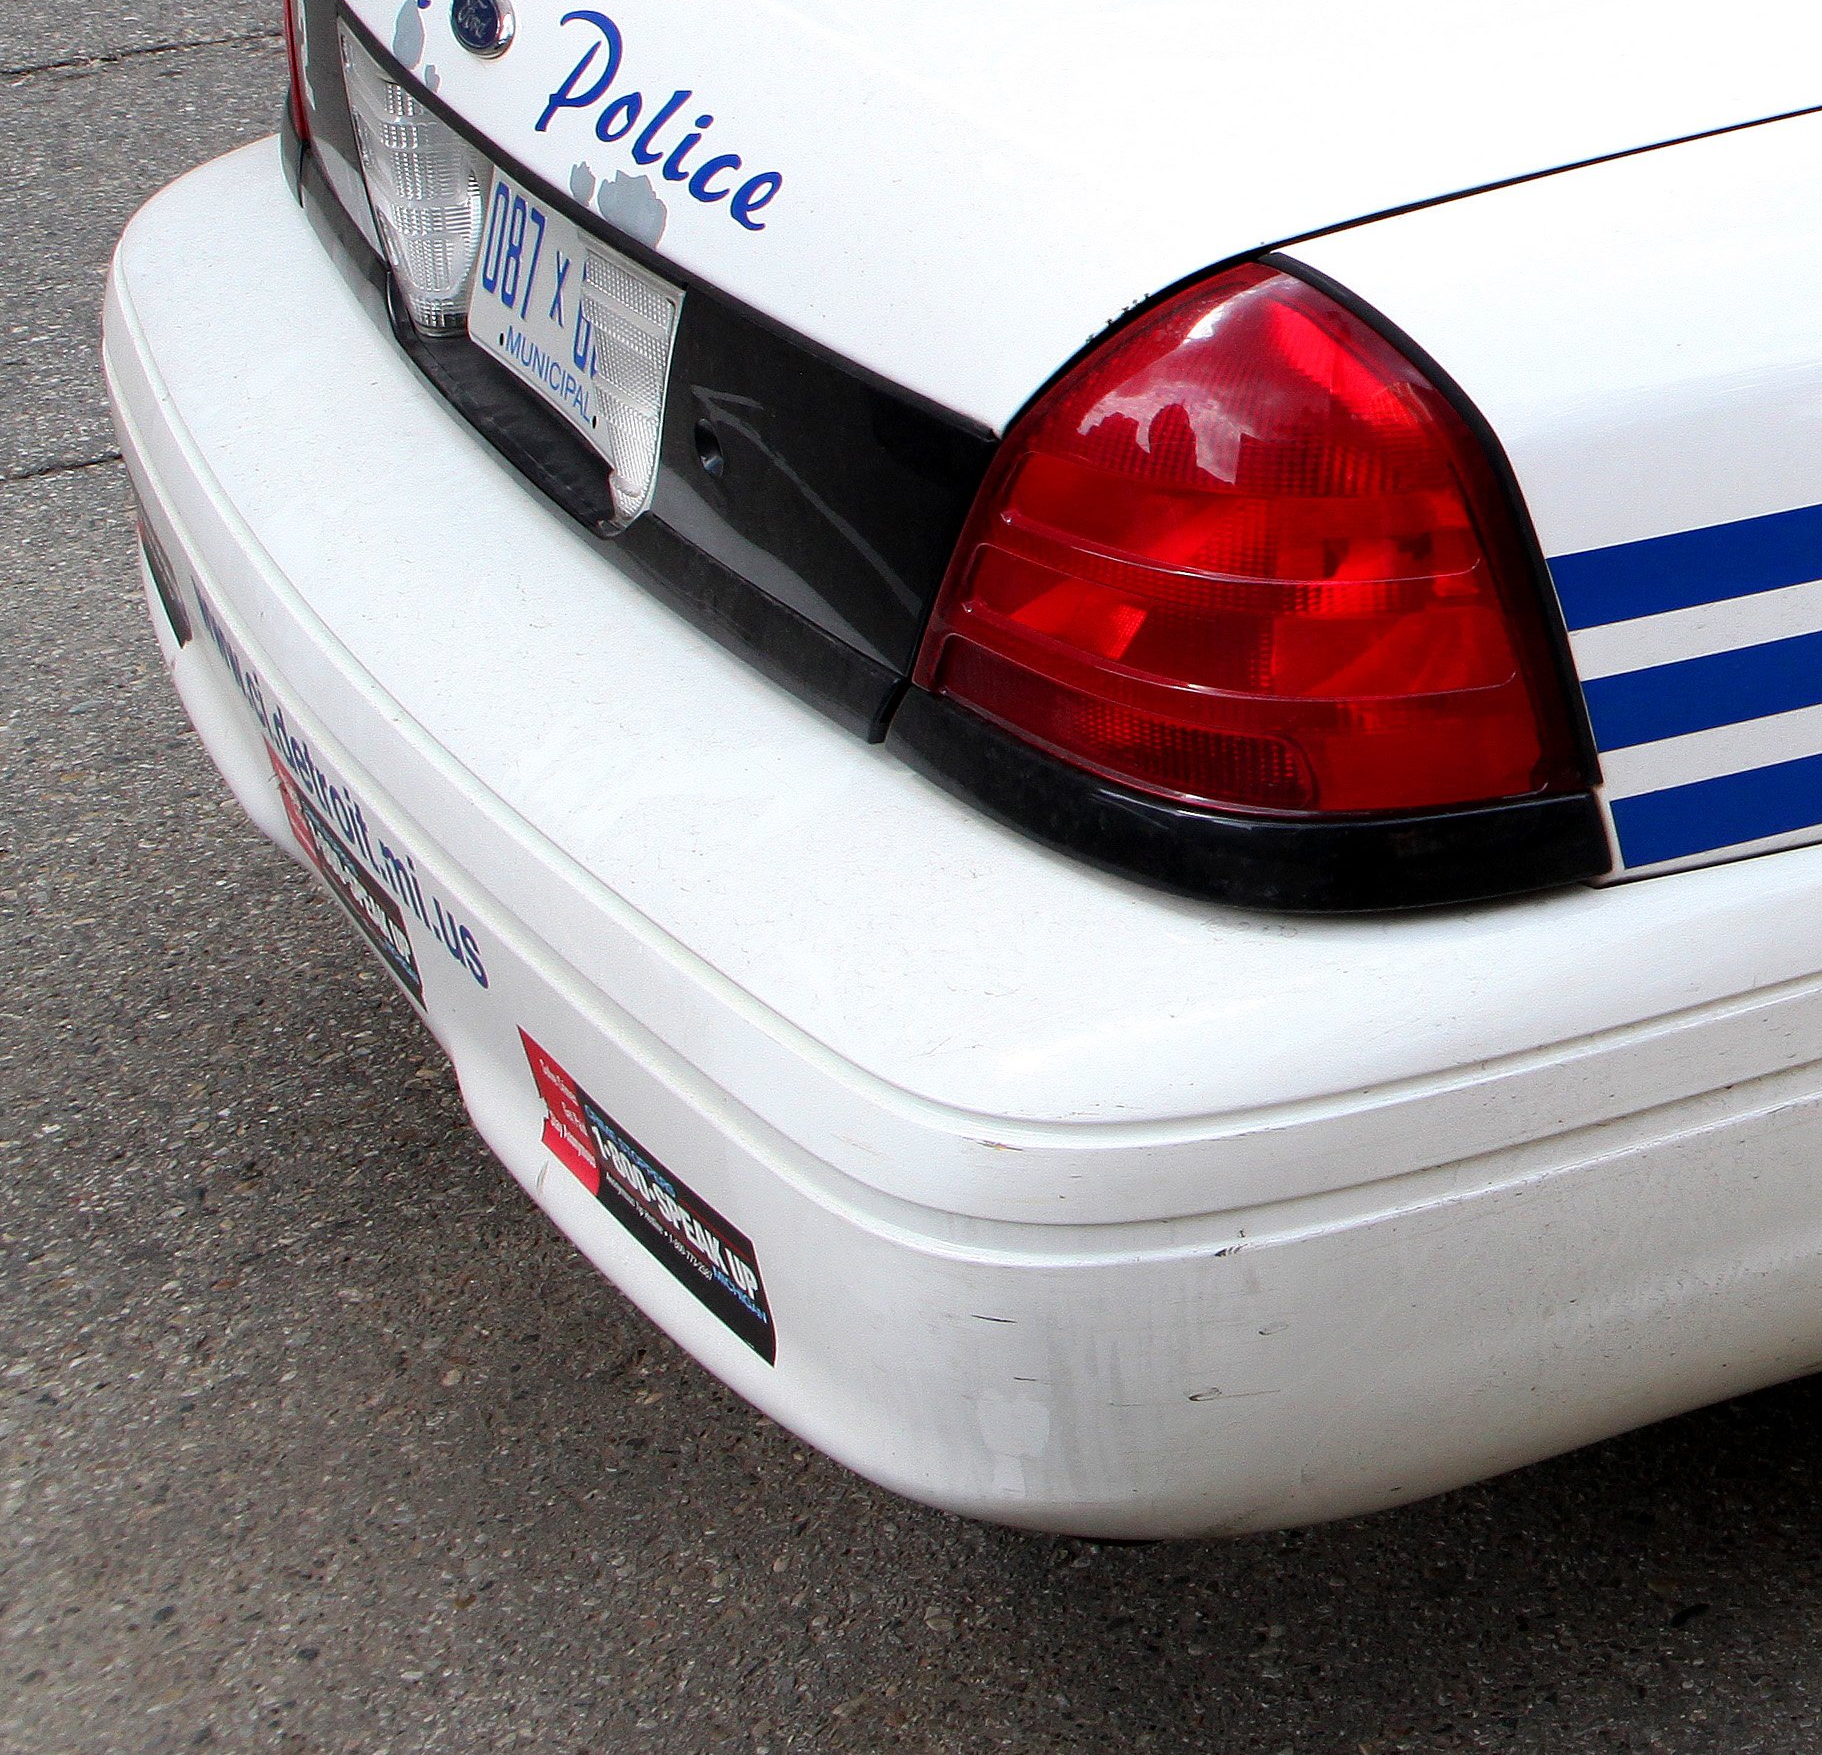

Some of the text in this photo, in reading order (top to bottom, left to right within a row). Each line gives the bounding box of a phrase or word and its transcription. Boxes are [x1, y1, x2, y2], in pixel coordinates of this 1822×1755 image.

[535, 10, 783, 231] Police
[482, 181, 547, 321] 087
[549, 249, 571, 329] X
[505, 325, 592, 424] MUNICIPAL
[724, 1247, 759, 1300] UP
